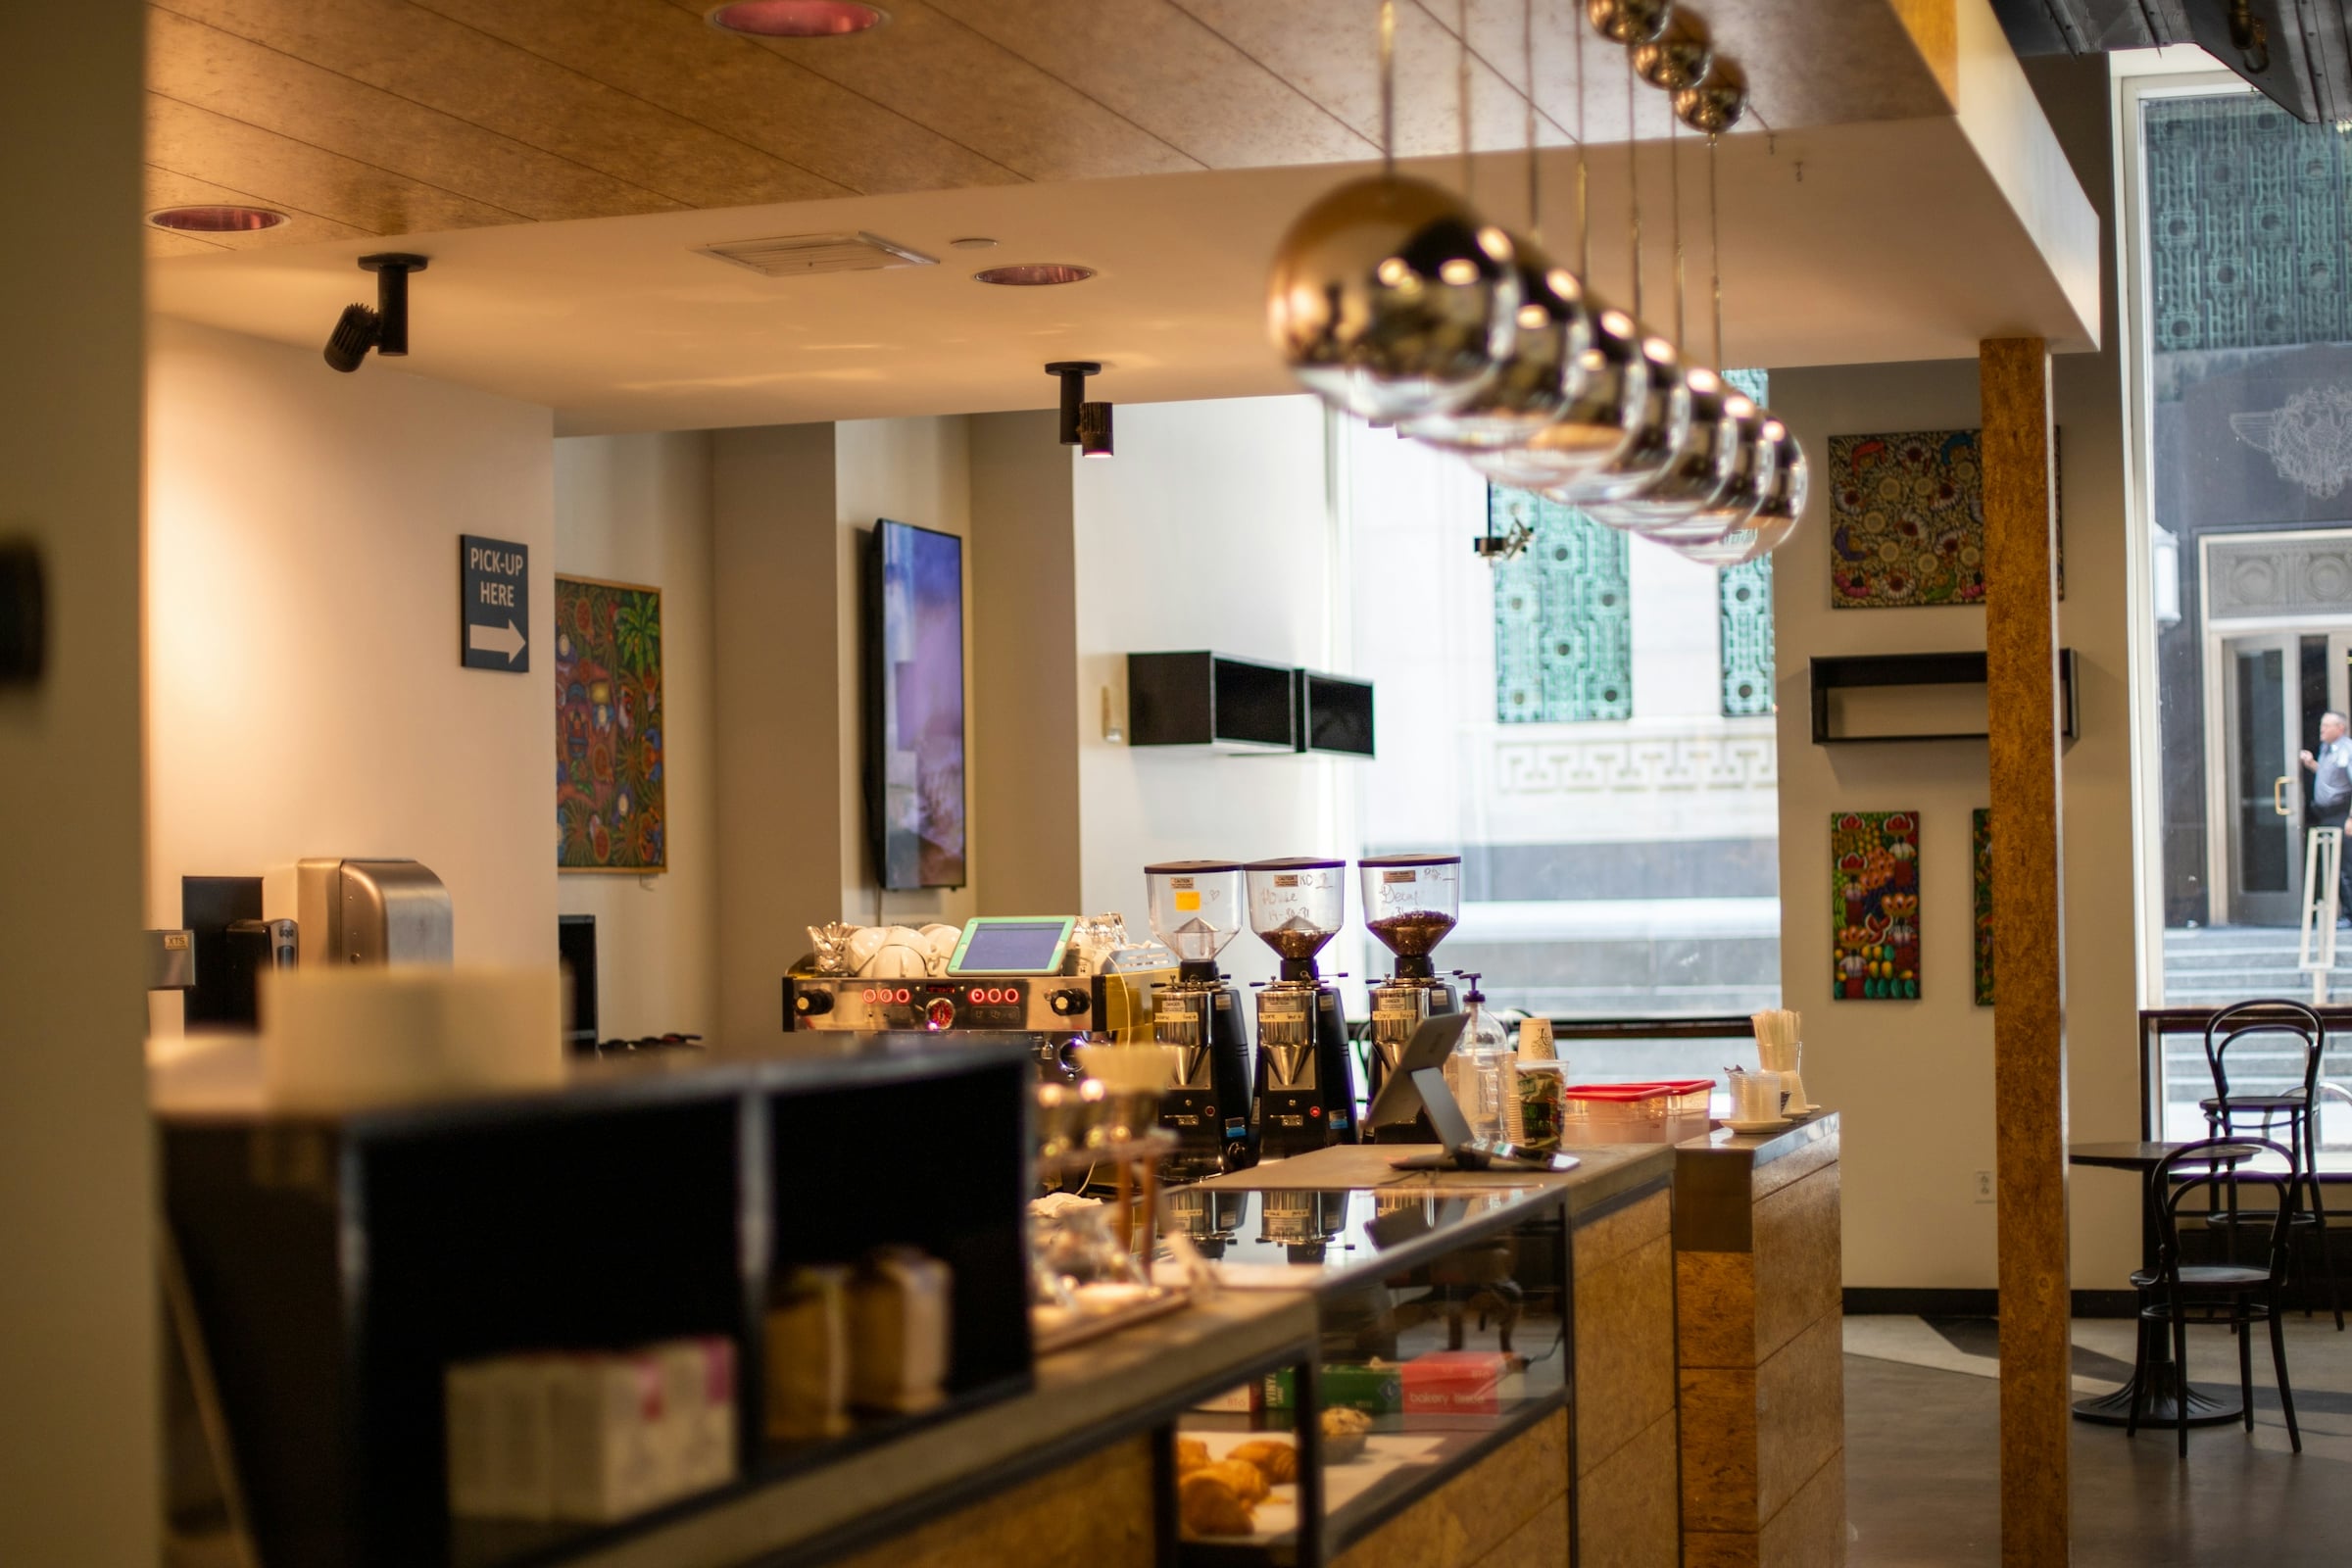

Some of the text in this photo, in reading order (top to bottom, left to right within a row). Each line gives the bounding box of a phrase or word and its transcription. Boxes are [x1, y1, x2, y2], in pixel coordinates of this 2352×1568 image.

[470, 547, 523, 576] PICK-UP
[480, 580, 514, 608] HERE
[168, 936, 185, 945] XTS
[1409, 1392, 1449, 1406] bakery
